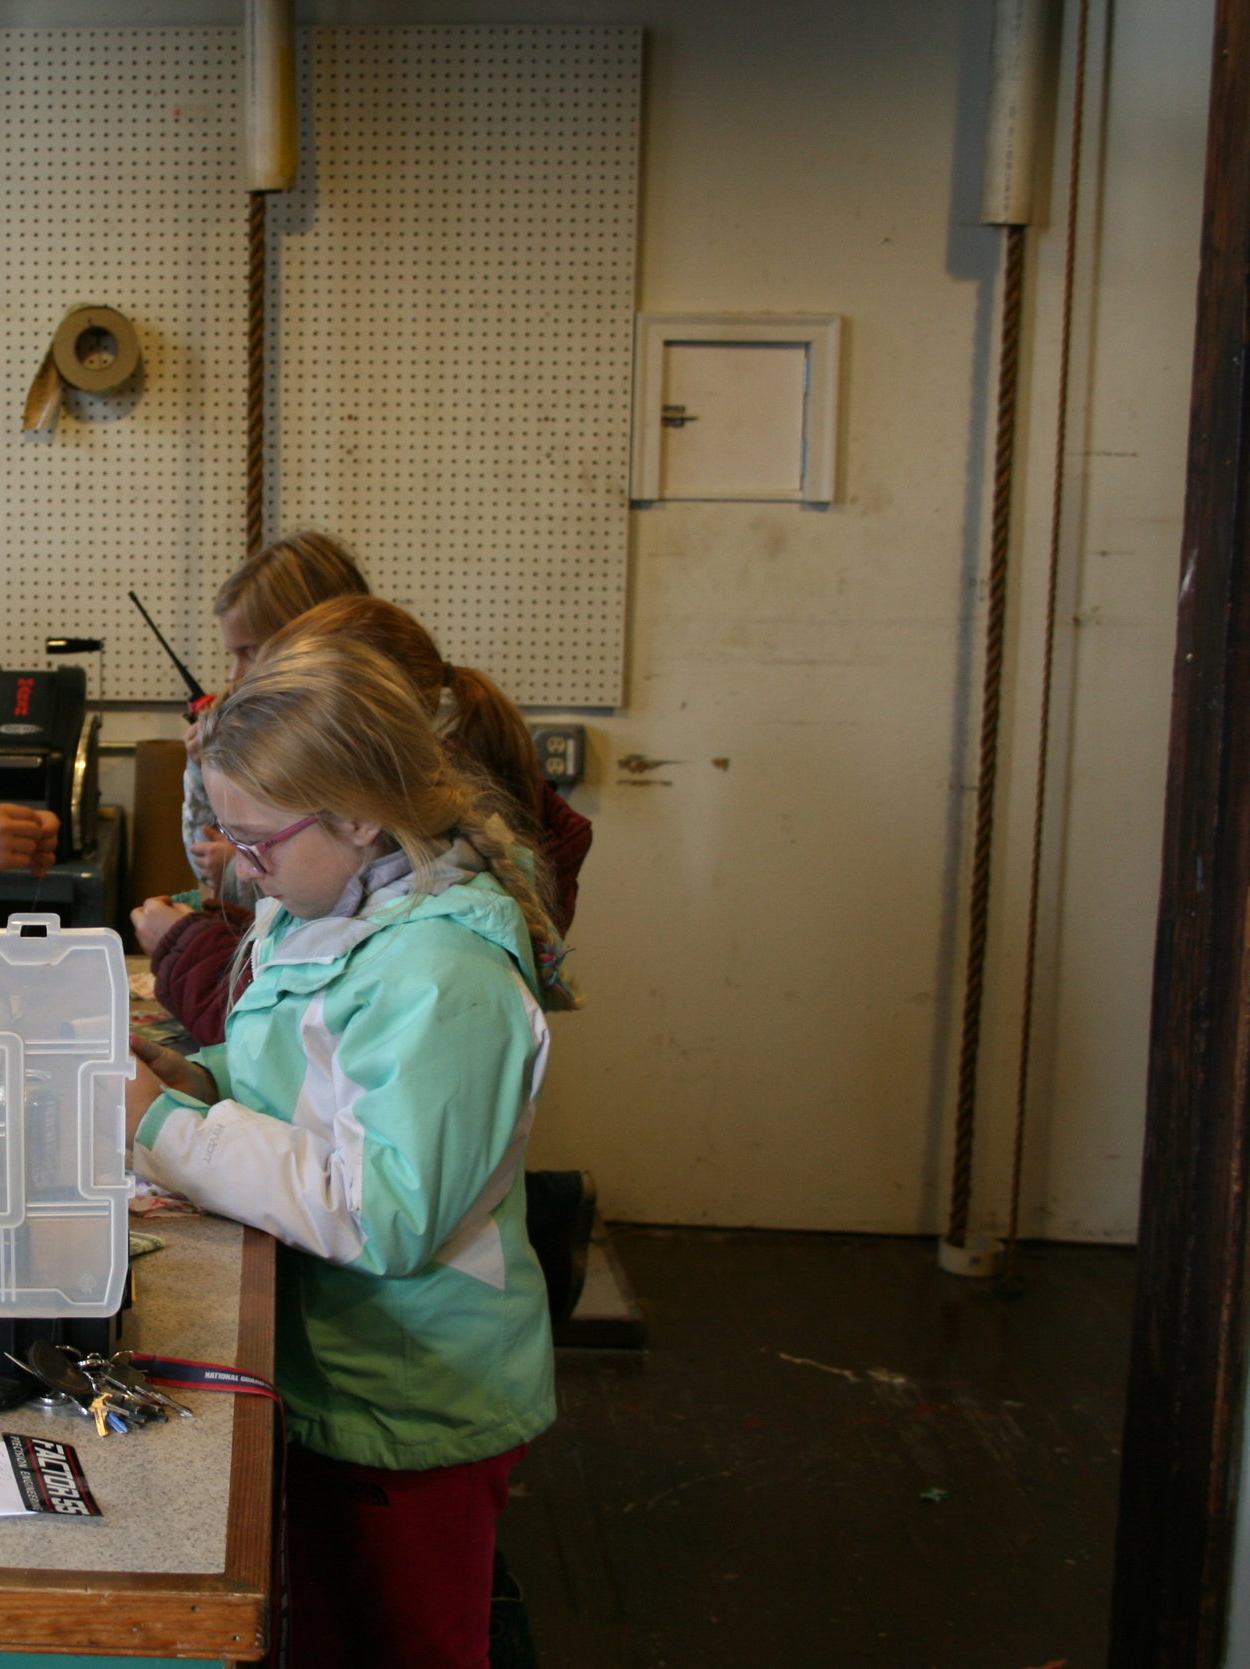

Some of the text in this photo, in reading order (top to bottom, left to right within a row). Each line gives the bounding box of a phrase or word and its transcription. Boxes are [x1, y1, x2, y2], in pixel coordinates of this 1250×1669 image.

[204, 1371, 239, 1382] NATIONAL
[10, 1435, 28, 1469] PRECISION
[32, 1439, 80, 1498] FACTOR
